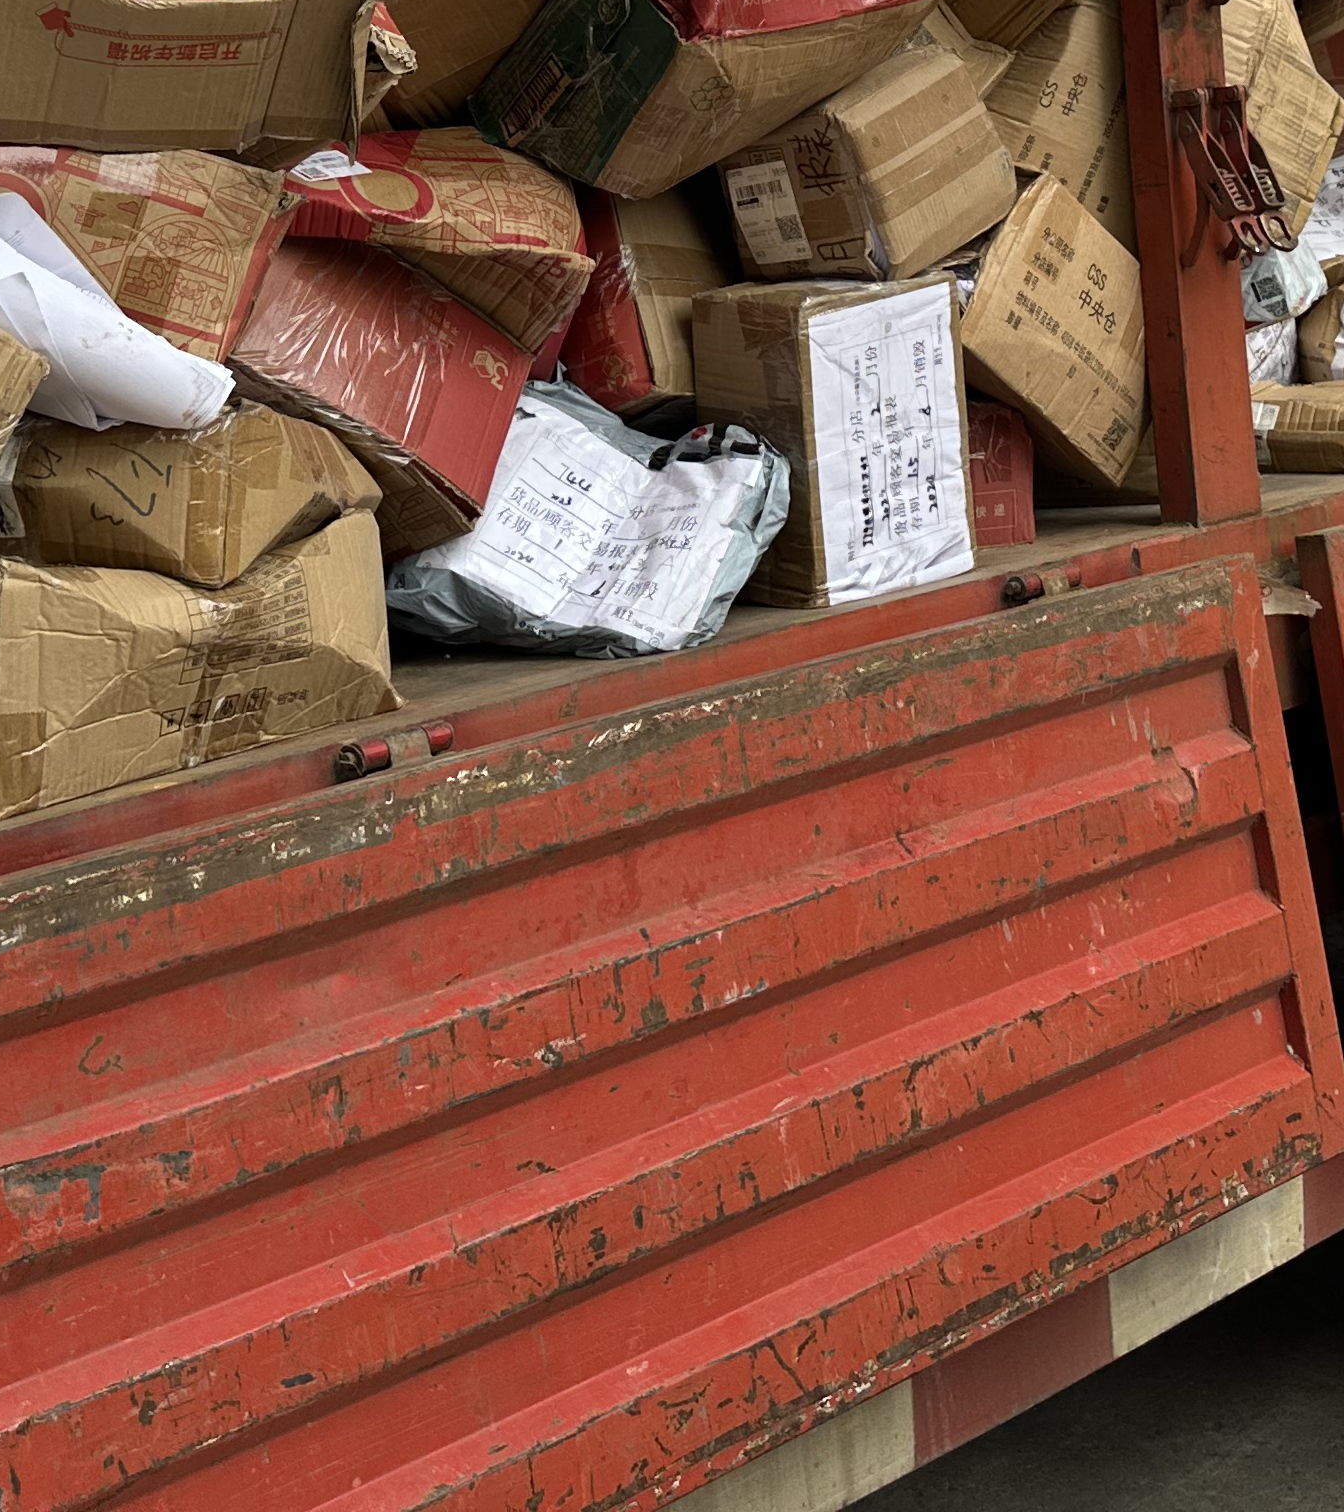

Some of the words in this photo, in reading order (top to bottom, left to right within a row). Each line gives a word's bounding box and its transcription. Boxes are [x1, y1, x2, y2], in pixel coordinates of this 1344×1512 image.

[105, 40, 242, 63] 开启新年祝福
[1038, 79, 1059, 109] CSS
[1060, 71, 1088, 118] 中央仓
[1086, 263, 1109, 292] CSS
[1078, 288, 1118, 336] 中央仓
[864, 344, 879, 378] 月份
[849, 405, 866, 444] 分店
[496, 505, 532, 537] 存期
[600, 518, 618, 537] 年
[667, 515, 699, 532] 月份
[556, 571, 574, 591] 年
